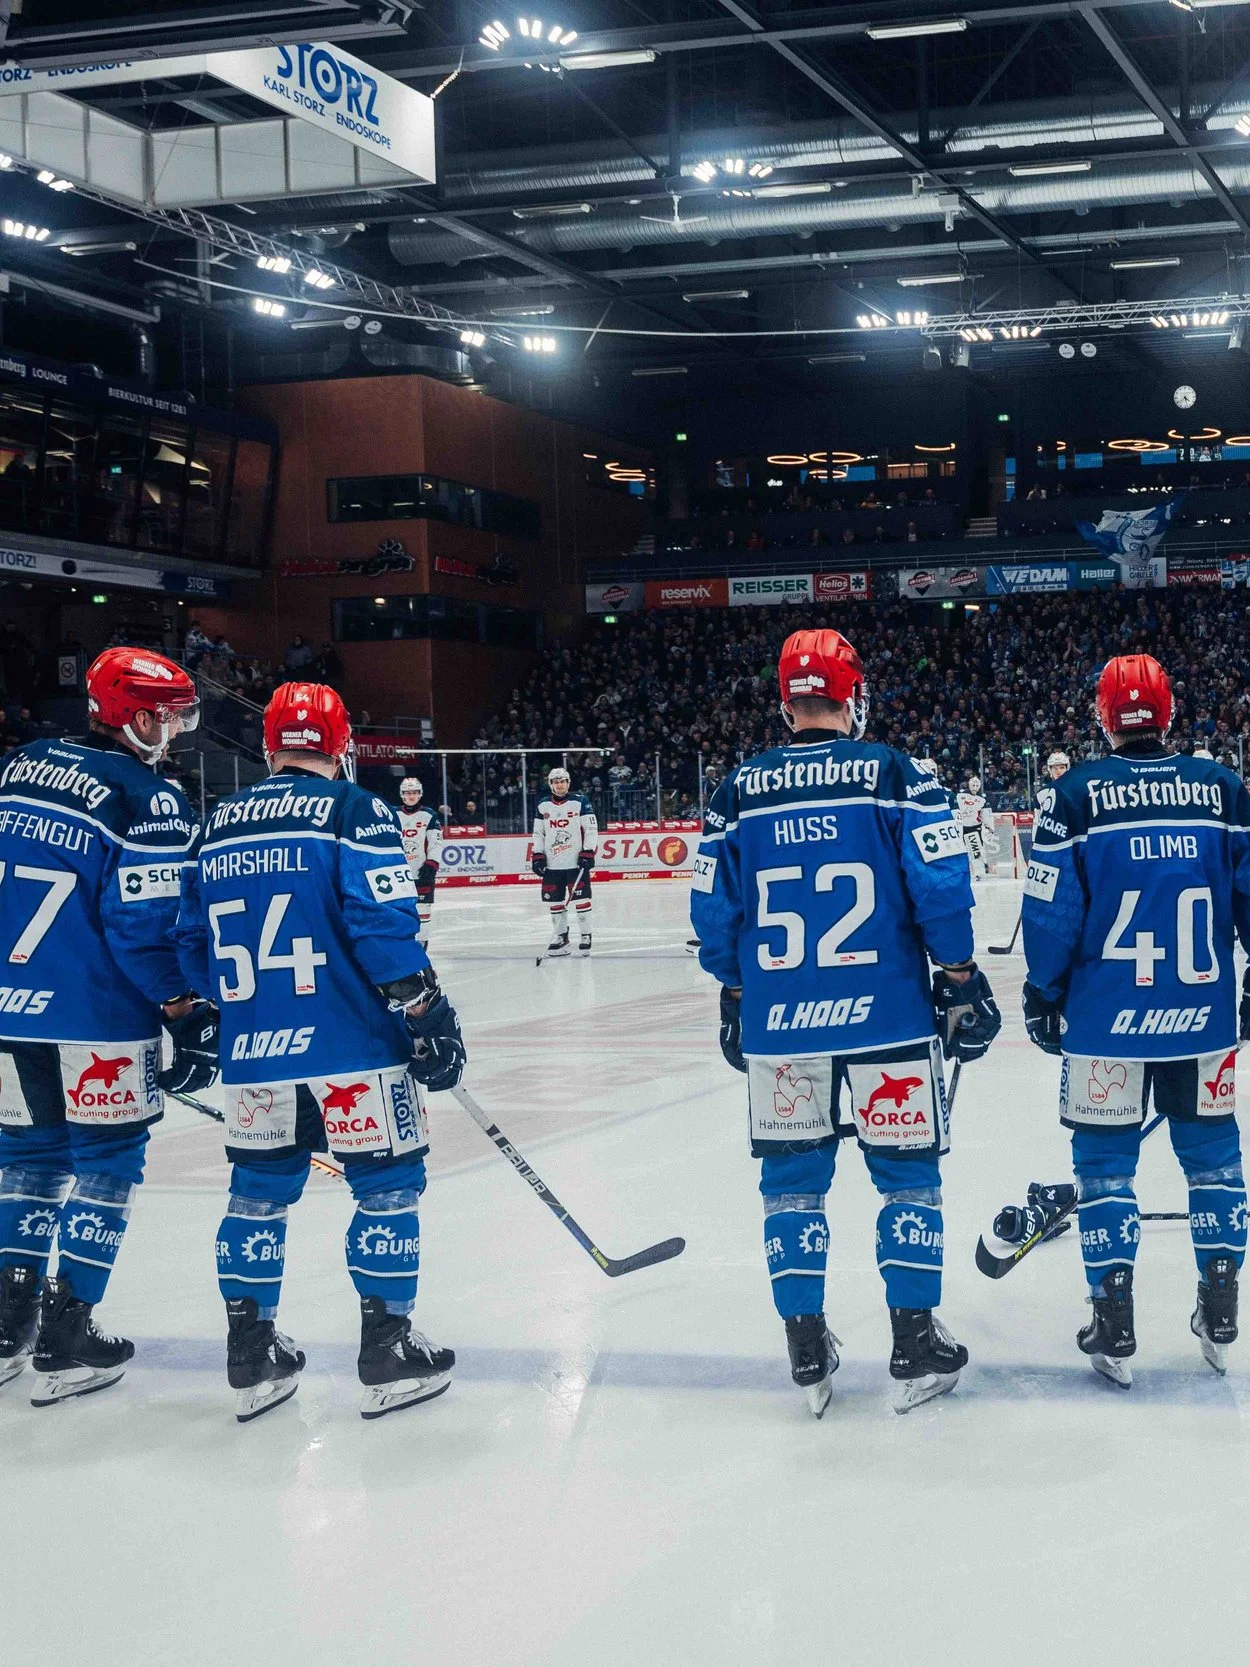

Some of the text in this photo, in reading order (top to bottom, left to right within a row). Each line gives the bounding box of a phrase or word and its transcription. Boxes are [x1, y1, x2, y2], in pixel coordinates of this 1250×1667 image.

[277, 42, 379, 126] STORZ
[264, 75, 391, 149] KARL STORZ ENDOSKOPE
[32, 367, 68, 386] LOUNGE
[108, 387, 153, 408] BIERKULTUR
[819, 579, 848, 589] Helios
[1002, 568, 1067, 584] WEDAM
[1081, 568, 1115, 579] Haller
[661, 584, 712, 602] reservix
[733, 579, 808, 595] REISSER
[0, 752, 111, 810] Fürstenberg
[733, 756, 880, 801] Fürstenberg
[1087, 775, 1223, 817] Fürstenberg
[204, 789, 335, 839] Fürstenberg
[550, 819, 570, 828] NCP
[774, 815, 838, 845] HUSS
[1130, 835, 1198, 860] OLIMB
[202, 846, 309, 884] MARSHALL
[0, 862, 77, 964] 7
[756, 862, 879, 971] 52
[1101, 886, 1220, 987] 40
[208, 893, 327, 1003] 54
[766, 995, 875, 1031] A.HAAS
[1110, 1006, 1212, 1035] A.HAAS
[81, 1089, 136, 1107] ORCA
[67, 1107, 139, 1119] the cutting group
[391, 1079, 414, 1141] STORZ
[871, 1111, 927, 1126] ORCA
[1075, 1103, 1138, 1117] Hahnemühle
[228, 1128, 287, 1141] Hahnemühle
[326, 1116, 379, 1134] ORCA
[759, 1118, 827, 1131] Hahnemühle
[870, 1129, 930, 1139] cutting group
[356, 1135, 383, 1145] group
